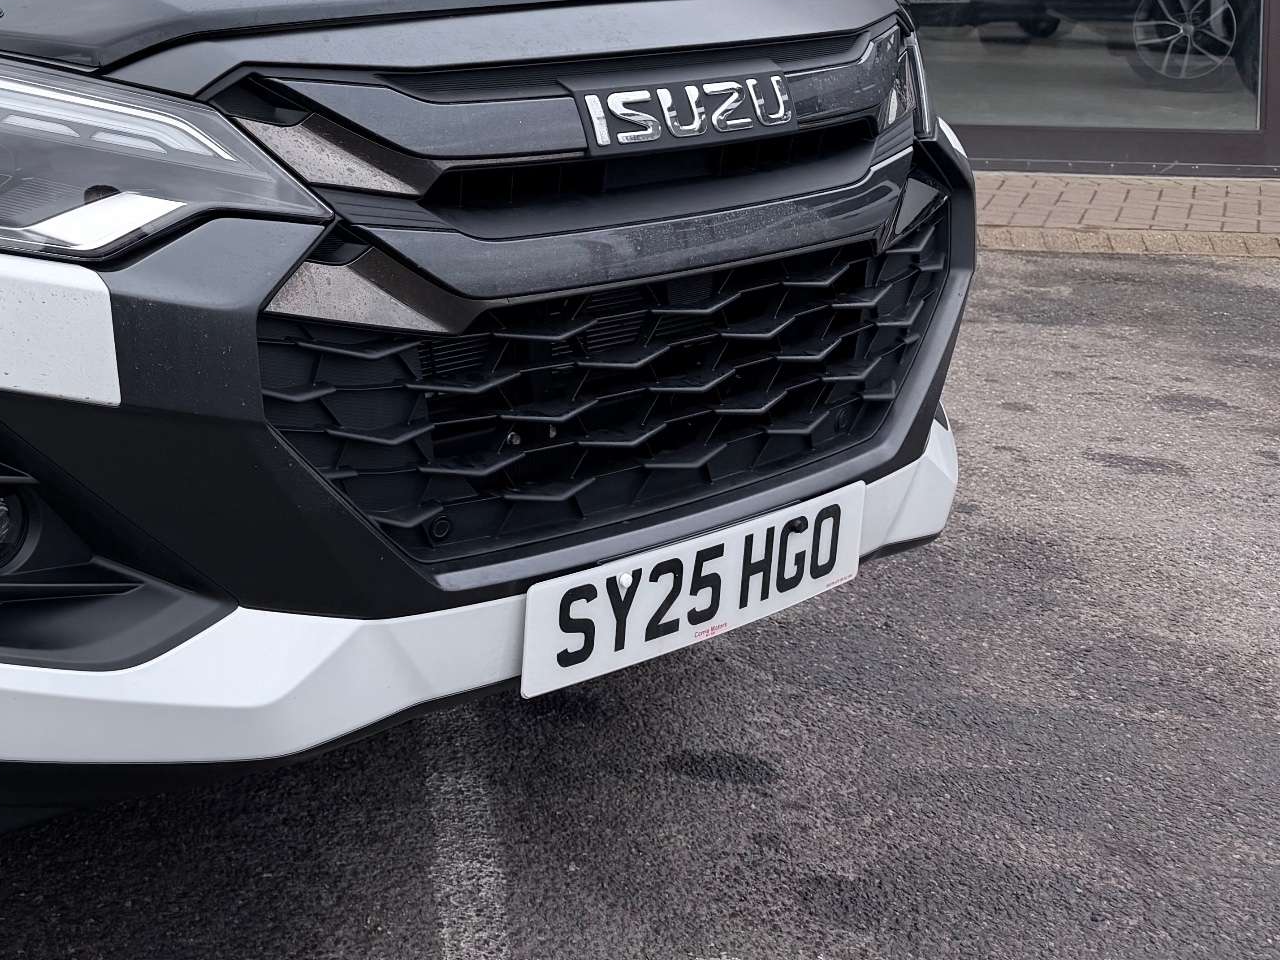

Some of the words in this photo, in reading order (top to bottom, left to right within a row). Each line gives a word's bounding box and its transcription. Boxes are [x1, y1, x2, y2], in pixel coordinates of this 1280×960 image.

[584, 75, 792, 147] ISUZU
[556, 542, 725, 668] SY25
[738, 503, 842, 610] HGO
